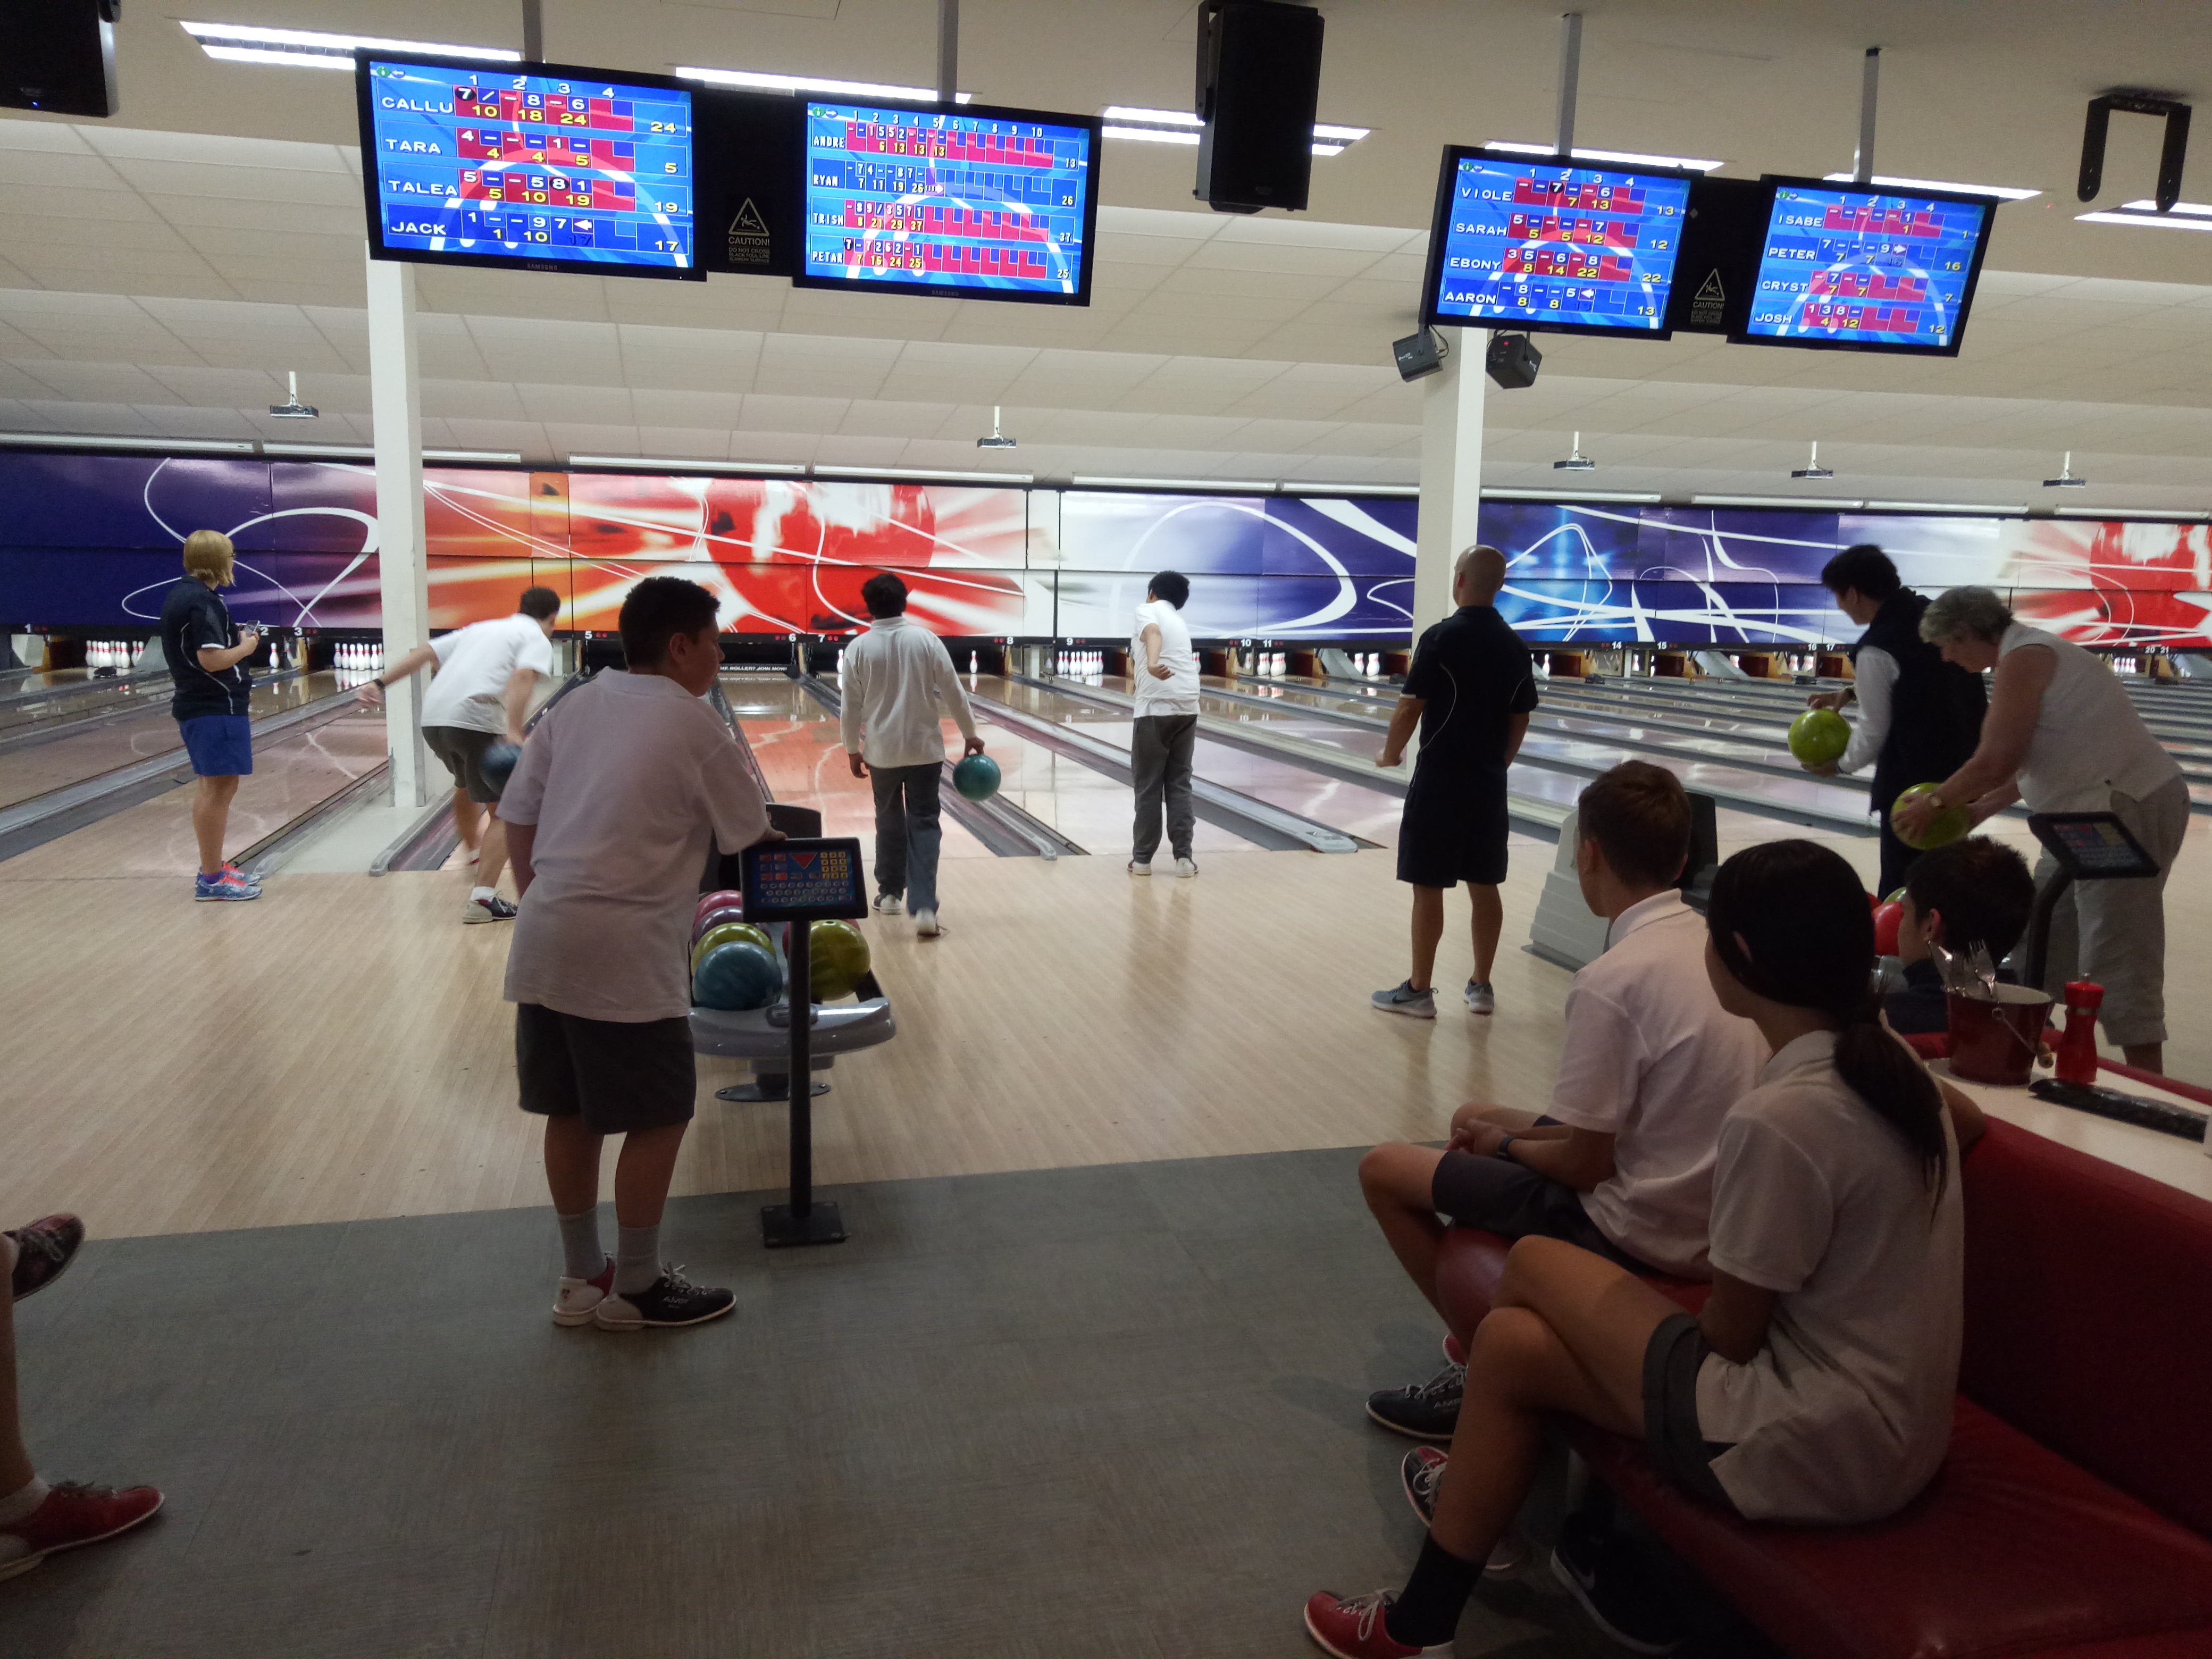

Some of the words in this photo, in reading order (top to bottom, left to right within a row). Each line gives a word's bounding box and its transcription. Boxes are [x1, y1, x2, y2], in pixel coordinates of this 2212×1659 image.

[469, 74, 477, 86] 1
[513, 79, 527, 90] 2
[558, 82, 571, 94] 3
[602, 87, 615, 98] 4
[458, 88, 472, 99] 7
[527, 94, 540, 106] 8
[572, 98, 585, 110] 6
[381, 97, 453, 113] CALLU
[473, 105, 498, 118] 10
[517, 109, 542, 121] 18
[560, 113, 586, 125] 24
[650, 121, 676, 133] 24
[853, 111, 858, 121] 1
[873, 112, 879, 123] 2
[893, 114, 899, 124] 3
[913, 115, 918, 127] 4
[933, 118, 939, 128] 5
[953, 120, 958, 130] 6
[973, 122, 978, 131] 7
[992, 123, 998, 133] 8
[1011, 125, 1017, 135] 9
[1032, 127, 1042, 138] 10
[461, 130, 474, 141] 4
[553, 138, 562, 148] 1
[385, 139, 441, 154] TARA
[487, 147, 499, 158] 4
[532, 152, 544, 162] 4
[576, 155, 588, 166] 5
[665, 162, 677, 173] 5
[814, 135, 845, 148] ANDRE
[893, 142, 905, 153] 13
[914, 144, 925, 155] 13
[934, 146, 945, 156] 13
[1065, 157, 1076, 168] 13
[464, 171, 476, 182] 5
[531, 177, 544, 188] 5
[552, 178, 566, 189] 8
[577, 180, 585, 191] 1
[1529, 168, 1536, 178] 1
[1561, 171, 1570, 180] 2
[1593, 174, 1603, 184] 3
[1625, 177, 1635, 187] 4
[388, 180, 458, 196] TALEA
[489, 188, 502, 199] 5
[522, 190, 546, 203] 10
[565, 194, 590, 206] 19
[654, 201, 678, 213] 19
[813, 174, 838, 186] RYAN
[873, 179, 883, 190] 11
[893, 181, 904, 191] 19
[911, 183, 924, 193] 26
[1062, 195, 1073, 205] 26
[1552, 182, 1562, 192] 7
[1601, 187, 1610, 197] 6
[1462, 187, 1513, 201] VIOLE
[1568, 197, 1578, 207] 7
[1591, 199, 1609, 210] 13
[1657, 205, 1674, 215] 13
[1840, 195, 1846, 205] 1
[1867, 198, 1876, 207] 2
[1897, 200, 1906, 210] 3
[1925, 203, 1934, 213] 4
[468, 212, 476, 223] 1
[533, 216, 546, 228] 9
[554, 218, 567, 229] 7
[813, 213, 844, 225] TRISH
[871, 218, 883, 228] 21
[891, 219, 903, 230] 29
[910, 220, 923, 231] 37
[1059, 232, 1071, 242] 37
[1513, 214, 1523, 224] 5
[1595, 221, 1605, 231] 7
[391, 222, 447, 236] JACK
[493, 229, 501, 239] 1
[523, 231, 548, 242] 10
[655, 240, 678, 252] 17
[728, 236, 769, 246] CAUTION!
[1455, 223, 1507, 236] SARAH
[1529, 229, 1539, 239] 5
[1561, 231, 1571, 241] 5
[1586, 234, 1603, 244] 12
[1650, 239, 1668, 249] 12
[1903, 225, 1909, 234] 1
[1962, 230, 1967, 239] 1
[1823, 239, 1832, 248] 7
[1880, 244, 1890, 253] 9
[812, 250, 843, 264] PETAR
[871, 256, 882, 265] 16
[890, 256, 901, 267] 24
[909, 258, 921, 269] 25
[1057, 269, 1070, 281] 25
[1507, 249, 1517, 258] 3
[1524, 250, 1534, 260] 5
[1556, 253, 1566, 263] 6
[1588, 255, 1598, 265] 8
[1769, 247, 1815, 260] PETER
[1836, 253, 1845, 262] 7
[1865, 254, 1874, 264] 7
[1945, 261, 1960, 271] 16
[1450, 257, 1501, 270] EBONY
[1523, 263, 1532, 273] 8
[1547, 265, 1564, 275] 14
[1577, 267, 1597, 278] 22
[1641, 273, 1661, 283] 22
[1830, 273, 1839, 282] 7
[1518, 284, 1528, 294] 8
[1566, 288, 1576, 297] 5
[1762, 281, 1809, 292] CRYST
[1829, 286, 1837, 294] 7
[1858, 287, 1866, 296] 7
[1945, 293, 1953, 302] 7
[1445, 291, 1496, 304] AARON
[1517, 297, 1527, 306] 8
[1549, 299, 1559, 308] 8
[1637, 306, 1655, 316] 13
[1809, 304, 1815, 313] 1
[1822, 305, 1831, 314] 3
[1836, 306, 1846, 315] 8
[1755, 313, 1792, 324] JOSH
[1820, 317, 1829, 326] 4
[1842, 319, 1859, 328] 12
[1929, 324, 1945, 334] 12
[24, 624, 31, 633] 1
[260, 626, 269, 635] 2
[294, 627, 303, 636] 3
[584, 630, 592, 640] 5
[789, 633, 797, 642] 6
[818, 633, 825, 643] 7
[1241, 638, 1252, 647] 10
[1612, 641, 1622, 650] 14
[1657, 641, 1667, 650] 15
[1826, 643, 1835, 651] 17
